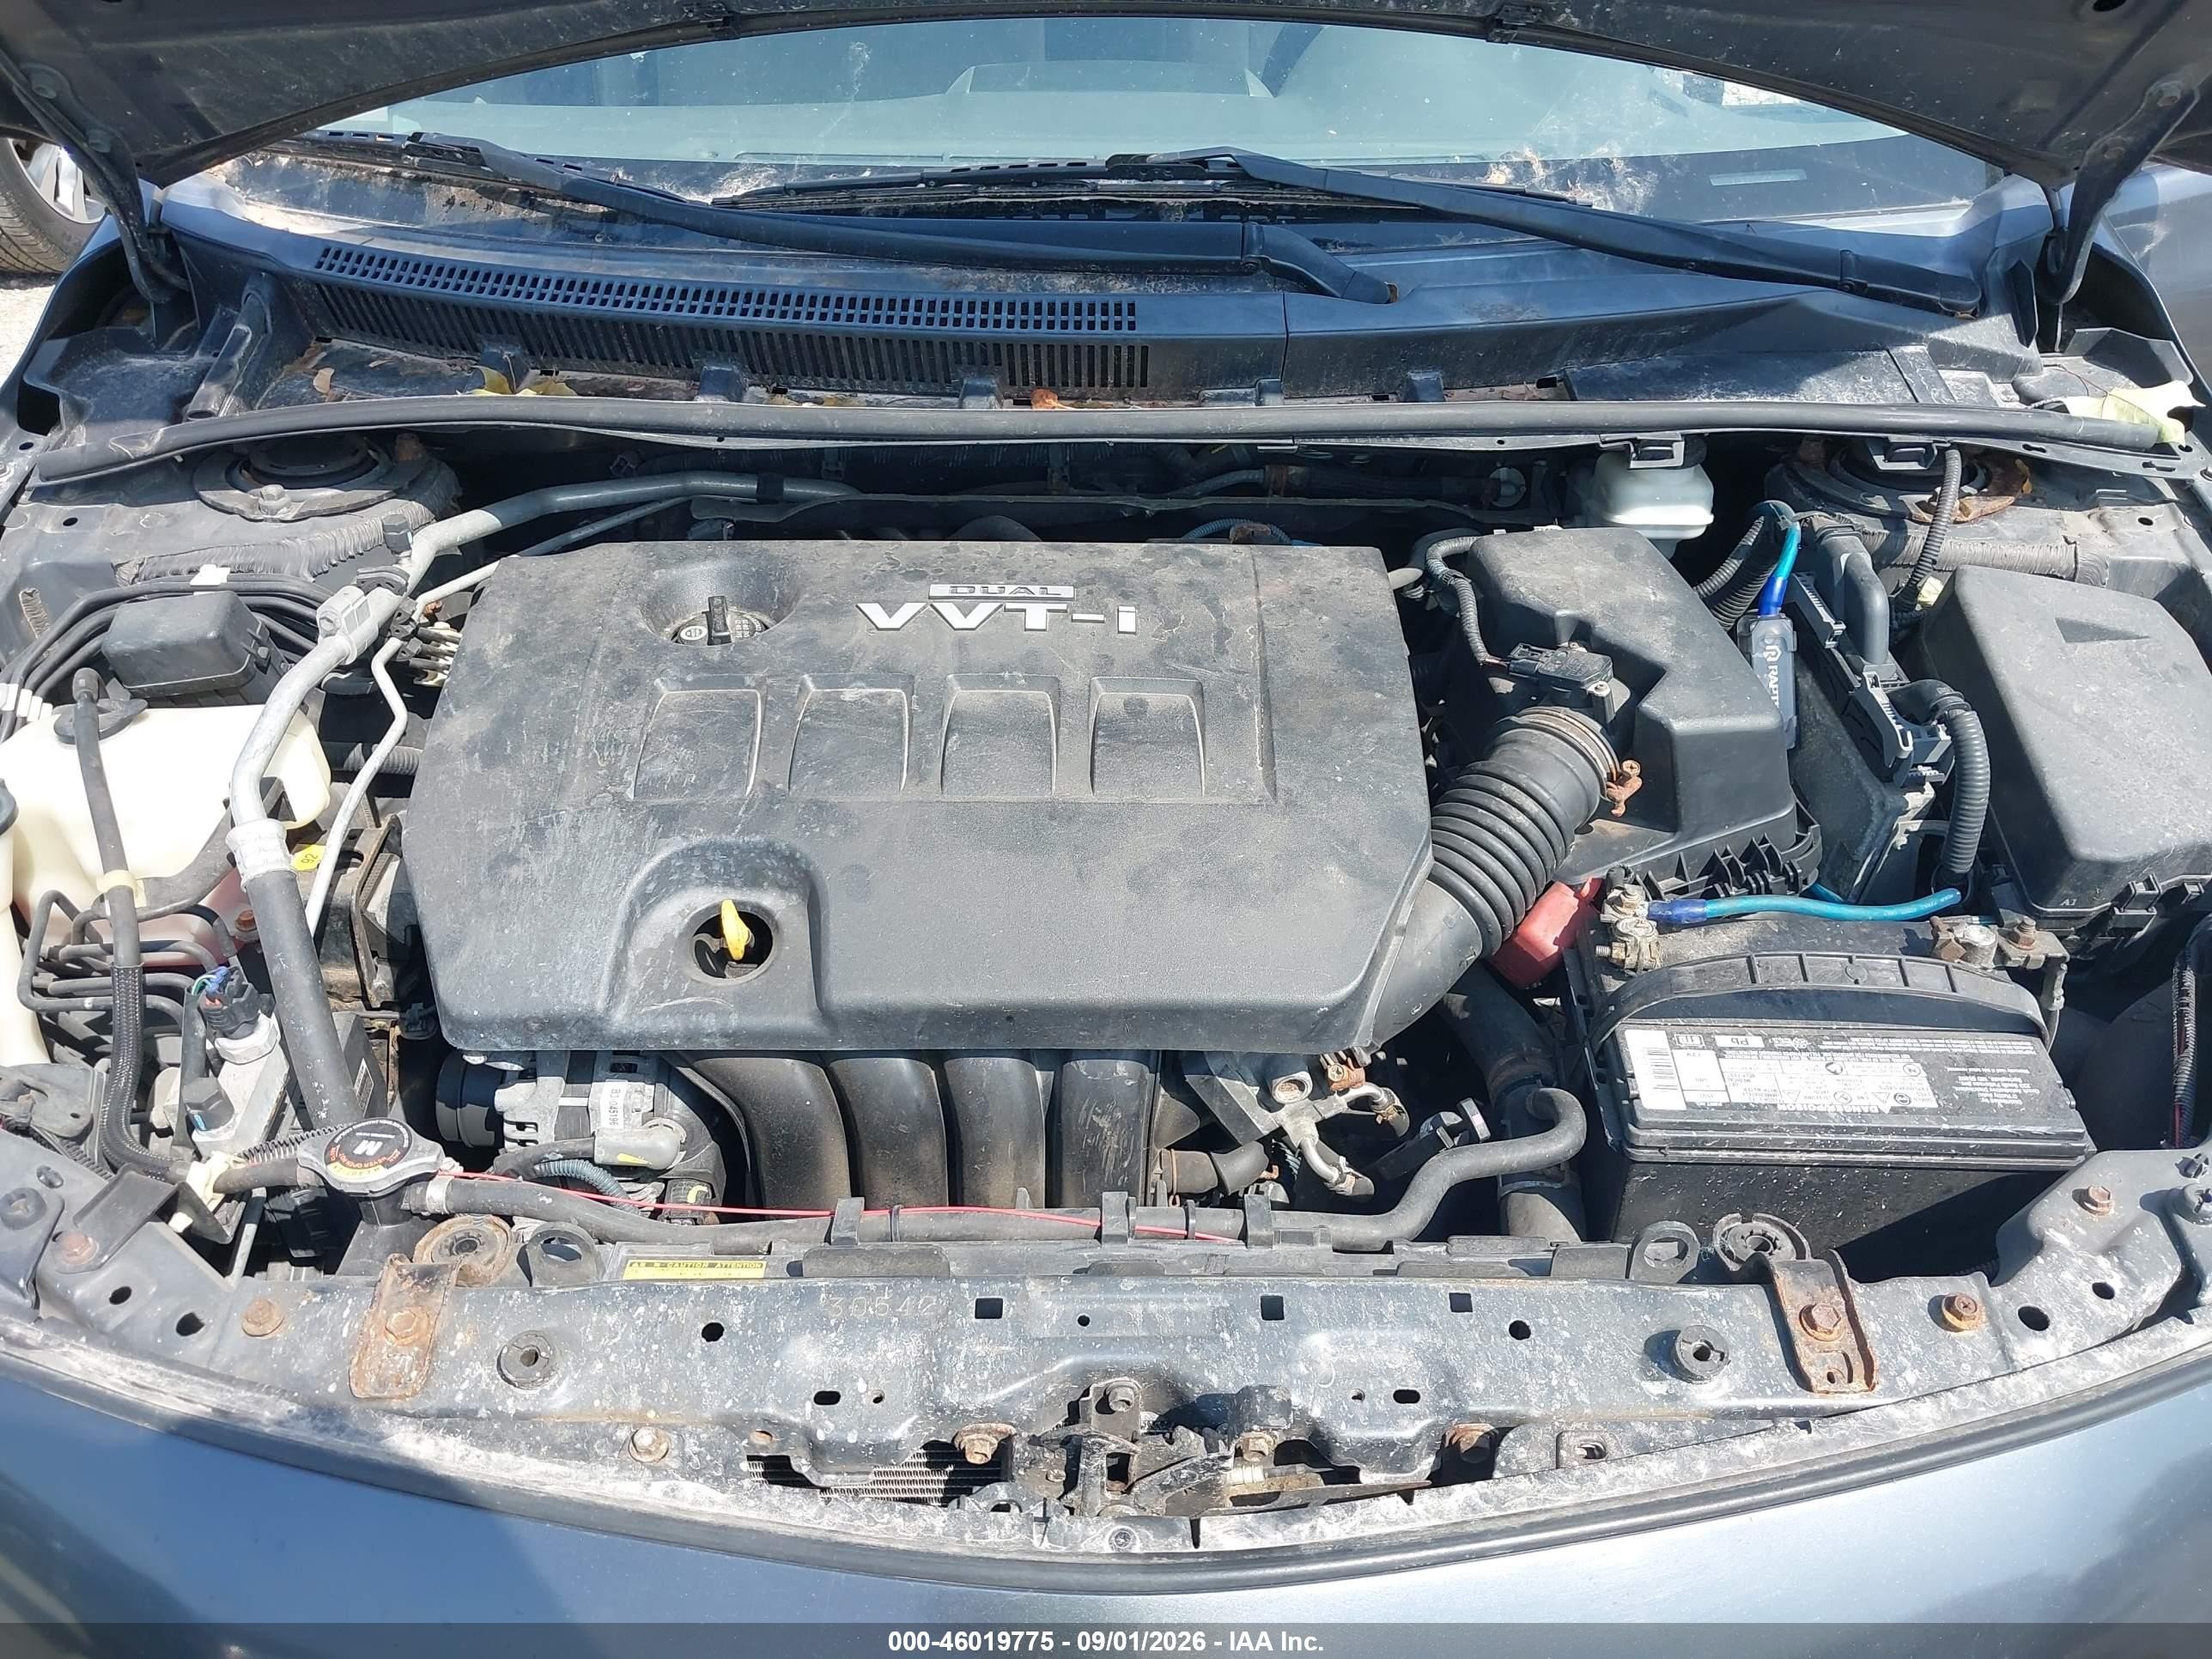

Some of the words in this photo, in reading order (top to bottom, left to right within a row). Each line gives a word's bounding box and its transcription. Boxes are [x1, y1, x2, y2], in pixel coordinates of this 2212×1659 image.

[948, 585, 1064, 597] DUAL
[1767, 665, 1780, 709] RAPT
[301, 853, 319, 864] 92
[1730, 1037, 1750, 1046] Pb
